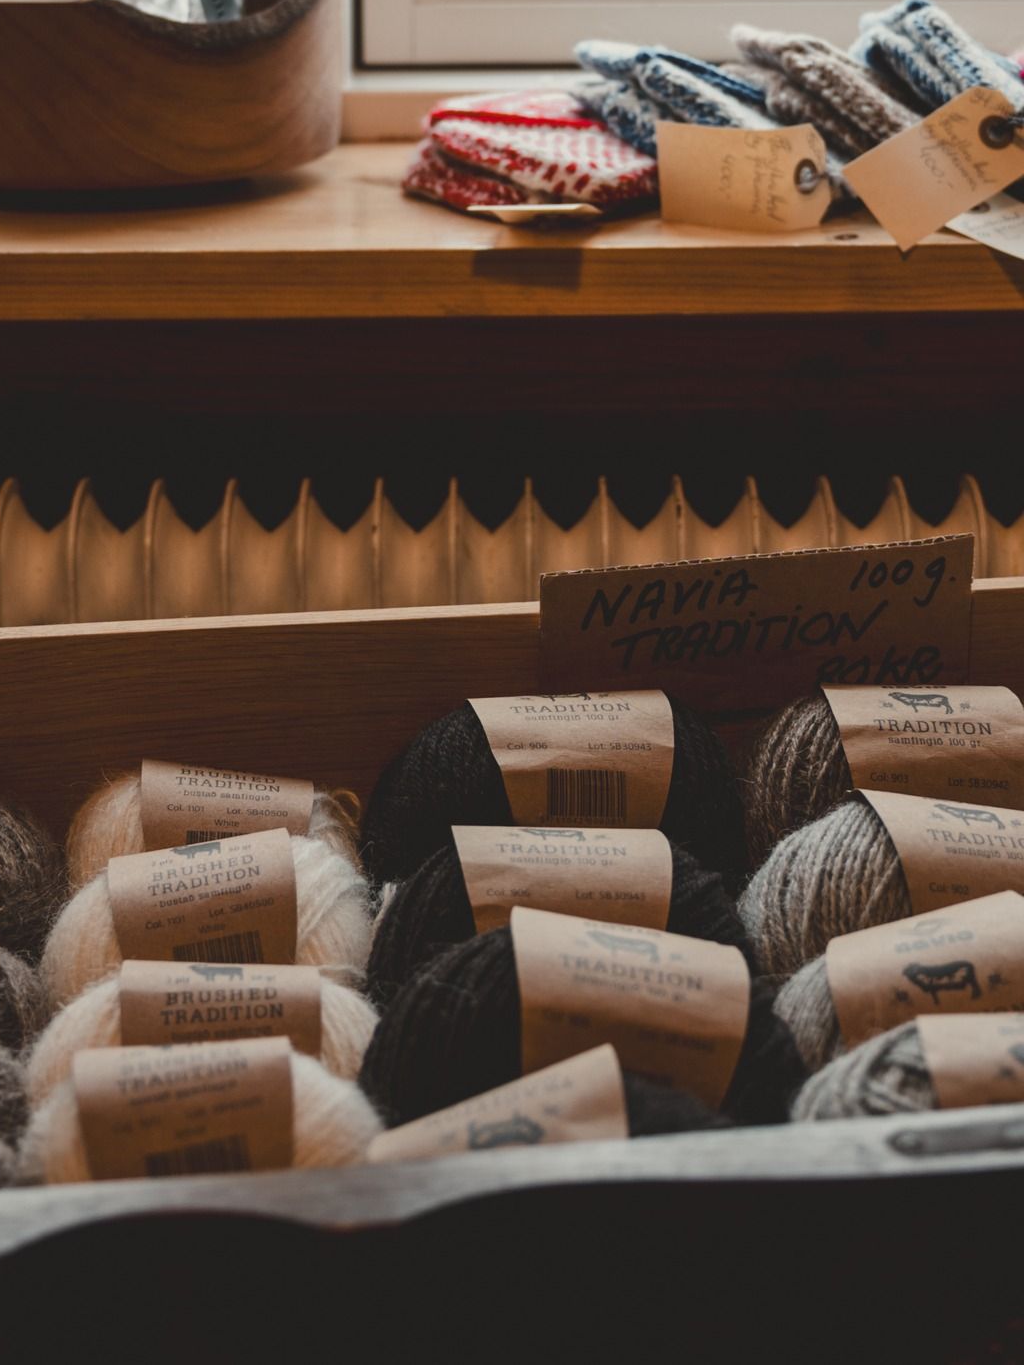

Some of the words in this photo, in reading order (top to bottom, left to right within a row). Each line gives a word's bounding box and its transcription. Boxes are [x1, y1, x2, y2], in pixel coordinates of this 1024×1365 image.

[850, 557, 914, 591] 100
[509, 702, 631, 714] TRADITION
[874, 719, 992, 736] TRADITION
[529, 742, 548, 750] 906
[949, 737, 966, 746] 100
[176, 776, 280, 793] TRADITION
[181, 768, 276, 785] BRUSHED
[891, 773, 909, 784] 903
[187, 805, 205, 814] 1101
[214, 818, 240, 827] White
[496, 843, 627, 857] TRADITION
[152, 854, 254, 883] BRUSHED
[147, 865, 261, 897] TRADITION
[559, 953, 703, 991] TRADITION
[166, 987, 277, 1006] BRUSHED
[160, 1002, 284, 1025] TRADITION
